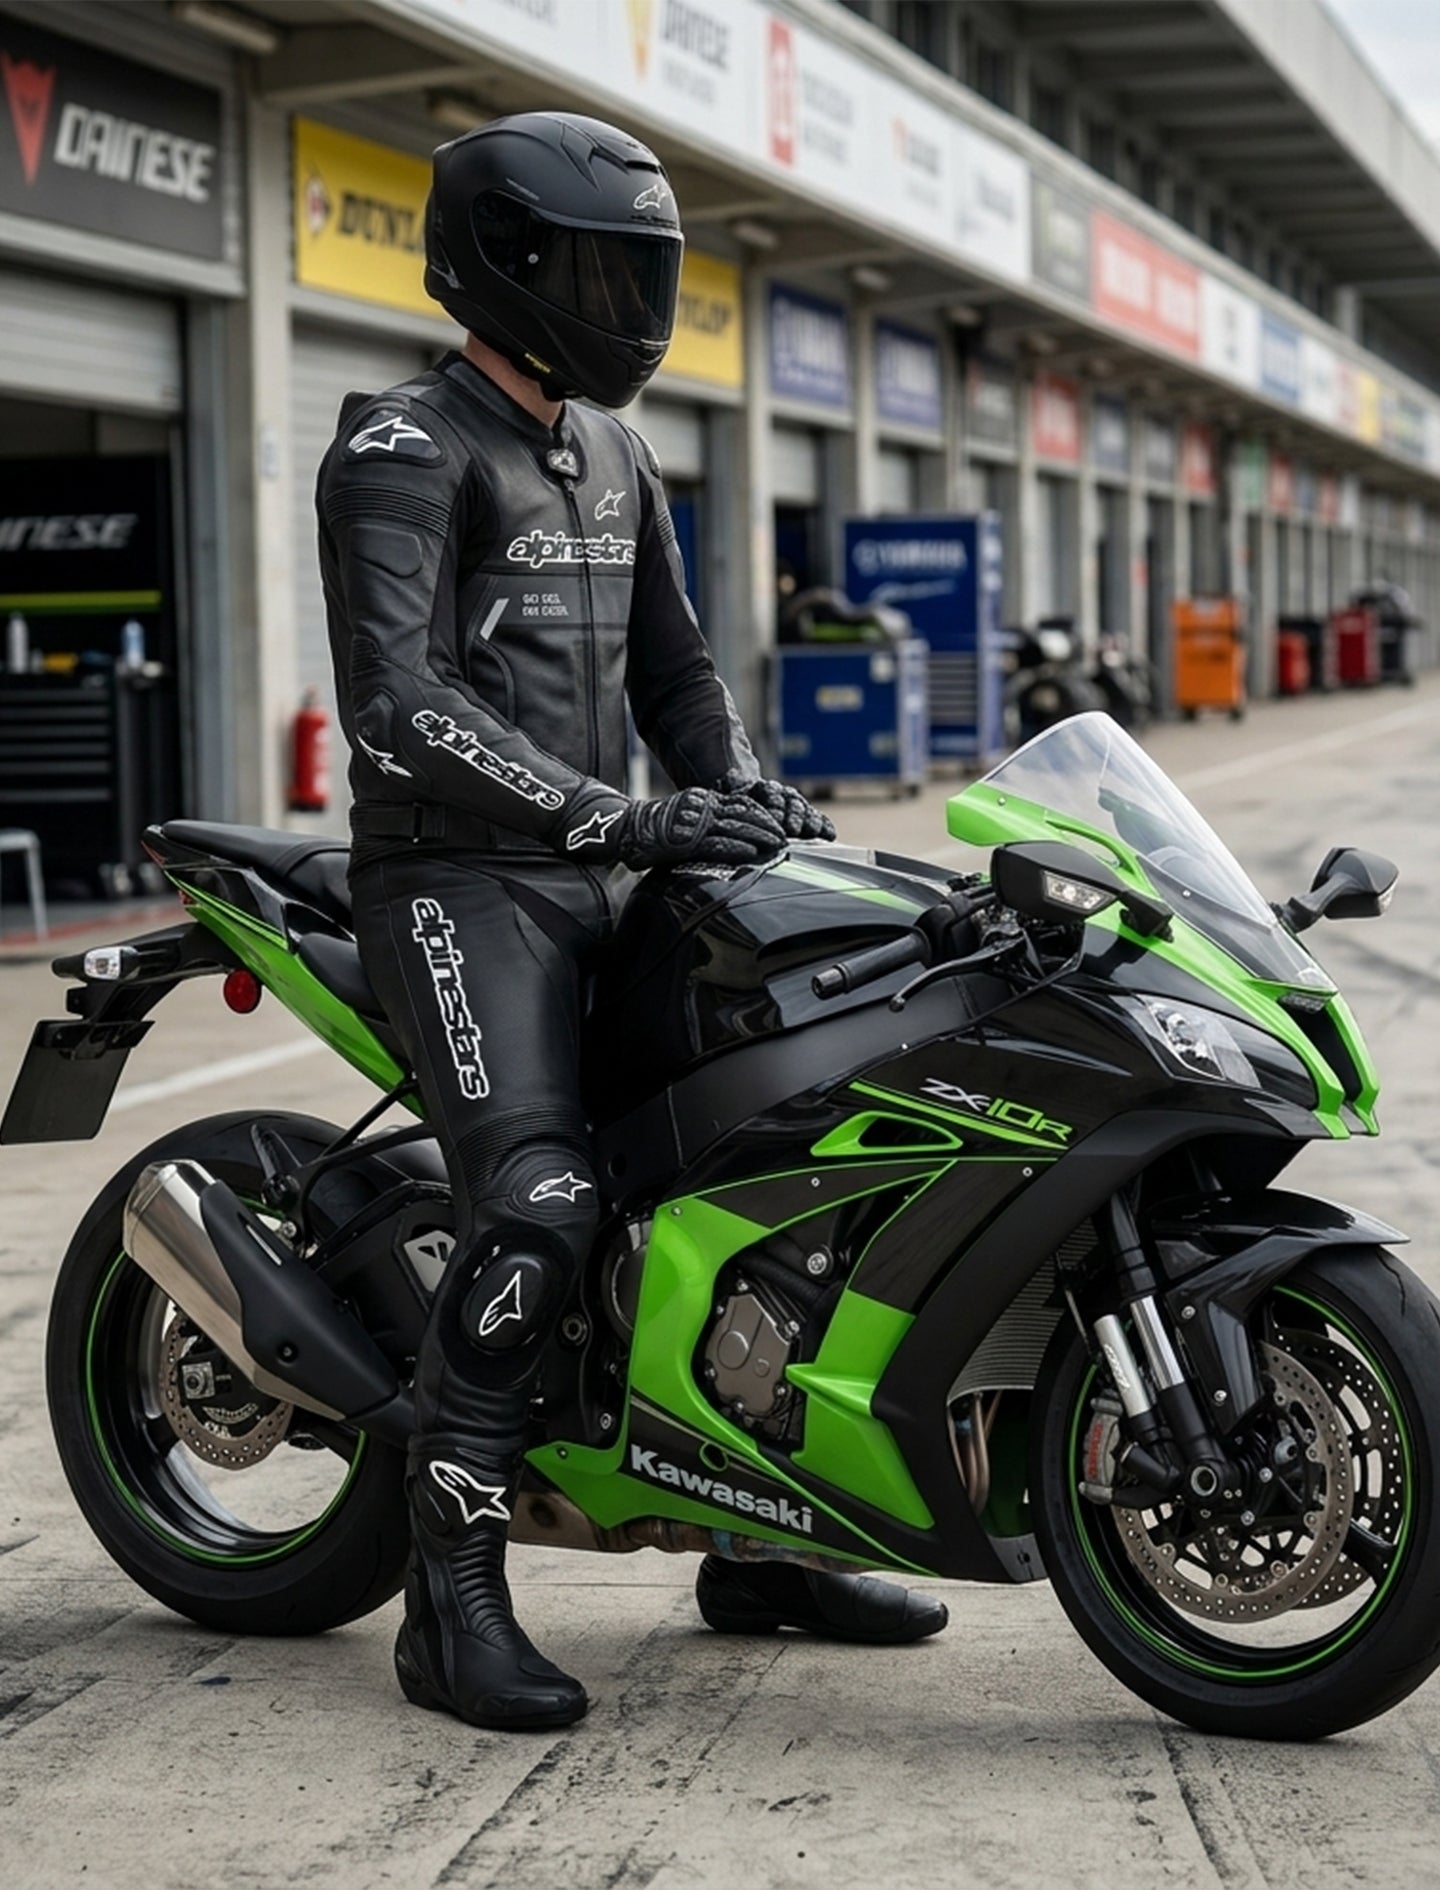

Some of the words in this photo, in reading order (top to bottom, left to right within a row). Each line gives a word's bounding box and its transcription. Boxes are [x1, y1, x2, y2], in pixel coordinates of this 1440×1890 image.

[54, 102, 216, 202] DAINESE
[412, 898, 490, 1099] alpinestars
[920, 1077, 1073, 1142] ZX-10R
[630, 1443, 813, 1534] Kawasaki
